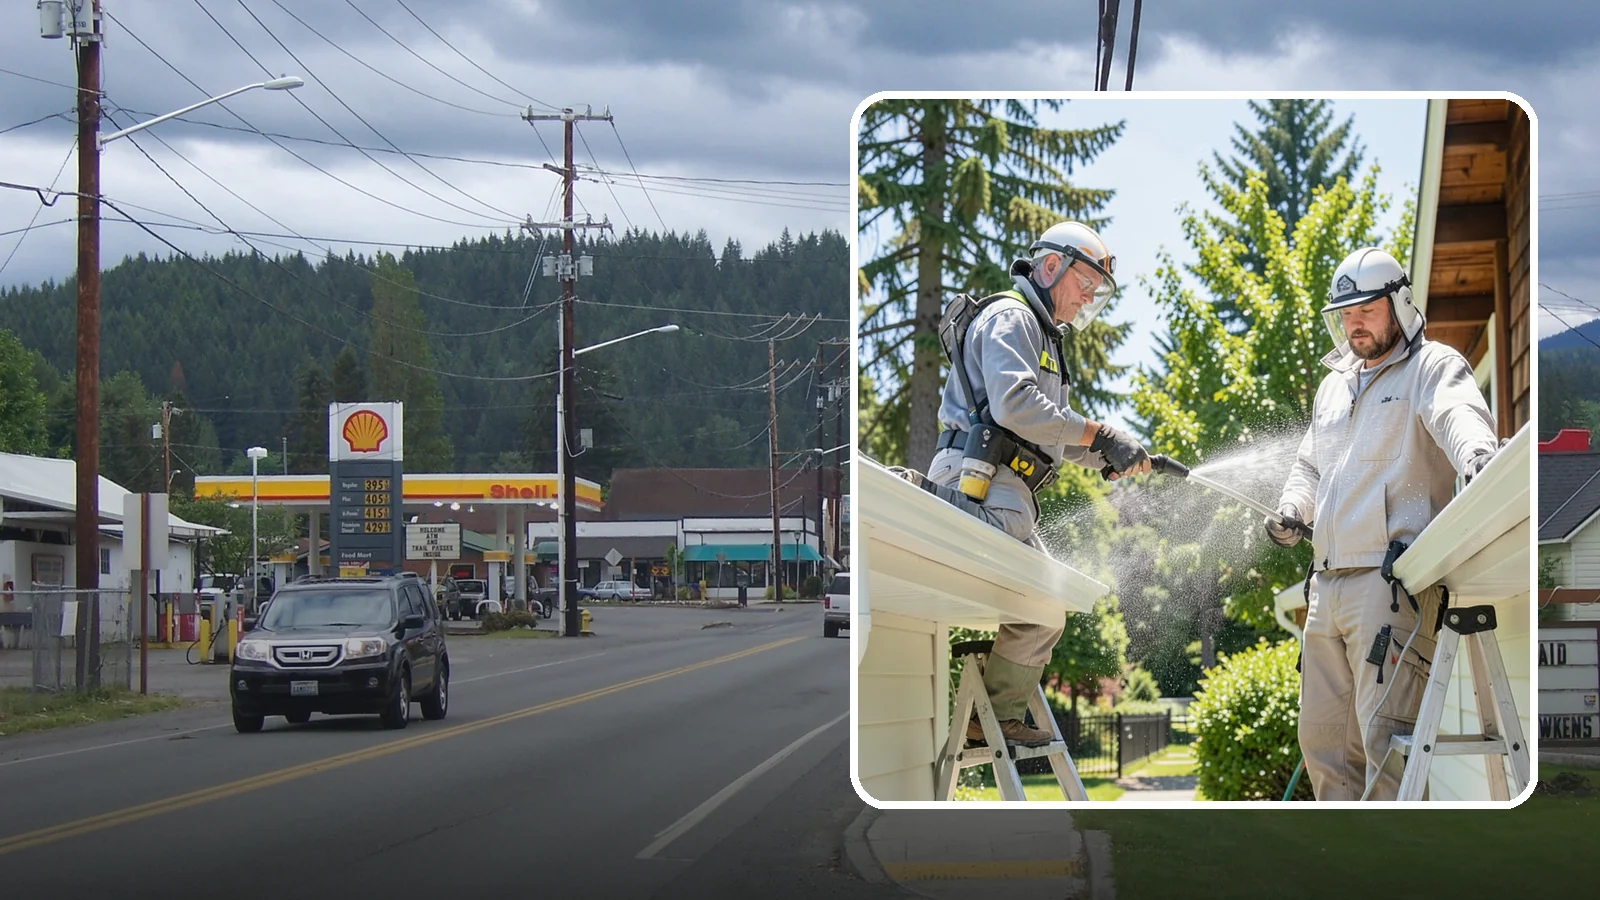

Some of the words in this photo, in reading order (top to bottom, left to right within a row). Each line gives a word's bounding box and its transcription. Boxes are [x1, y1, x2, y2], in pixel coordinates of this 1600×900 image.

[366, 480, 383, 490] 395
[490, 484, 547, 499] Shell
[366, 494, 383, 504] 405
[366, 508, 383, 518] 415
[366, 522, 383, 532] 429
